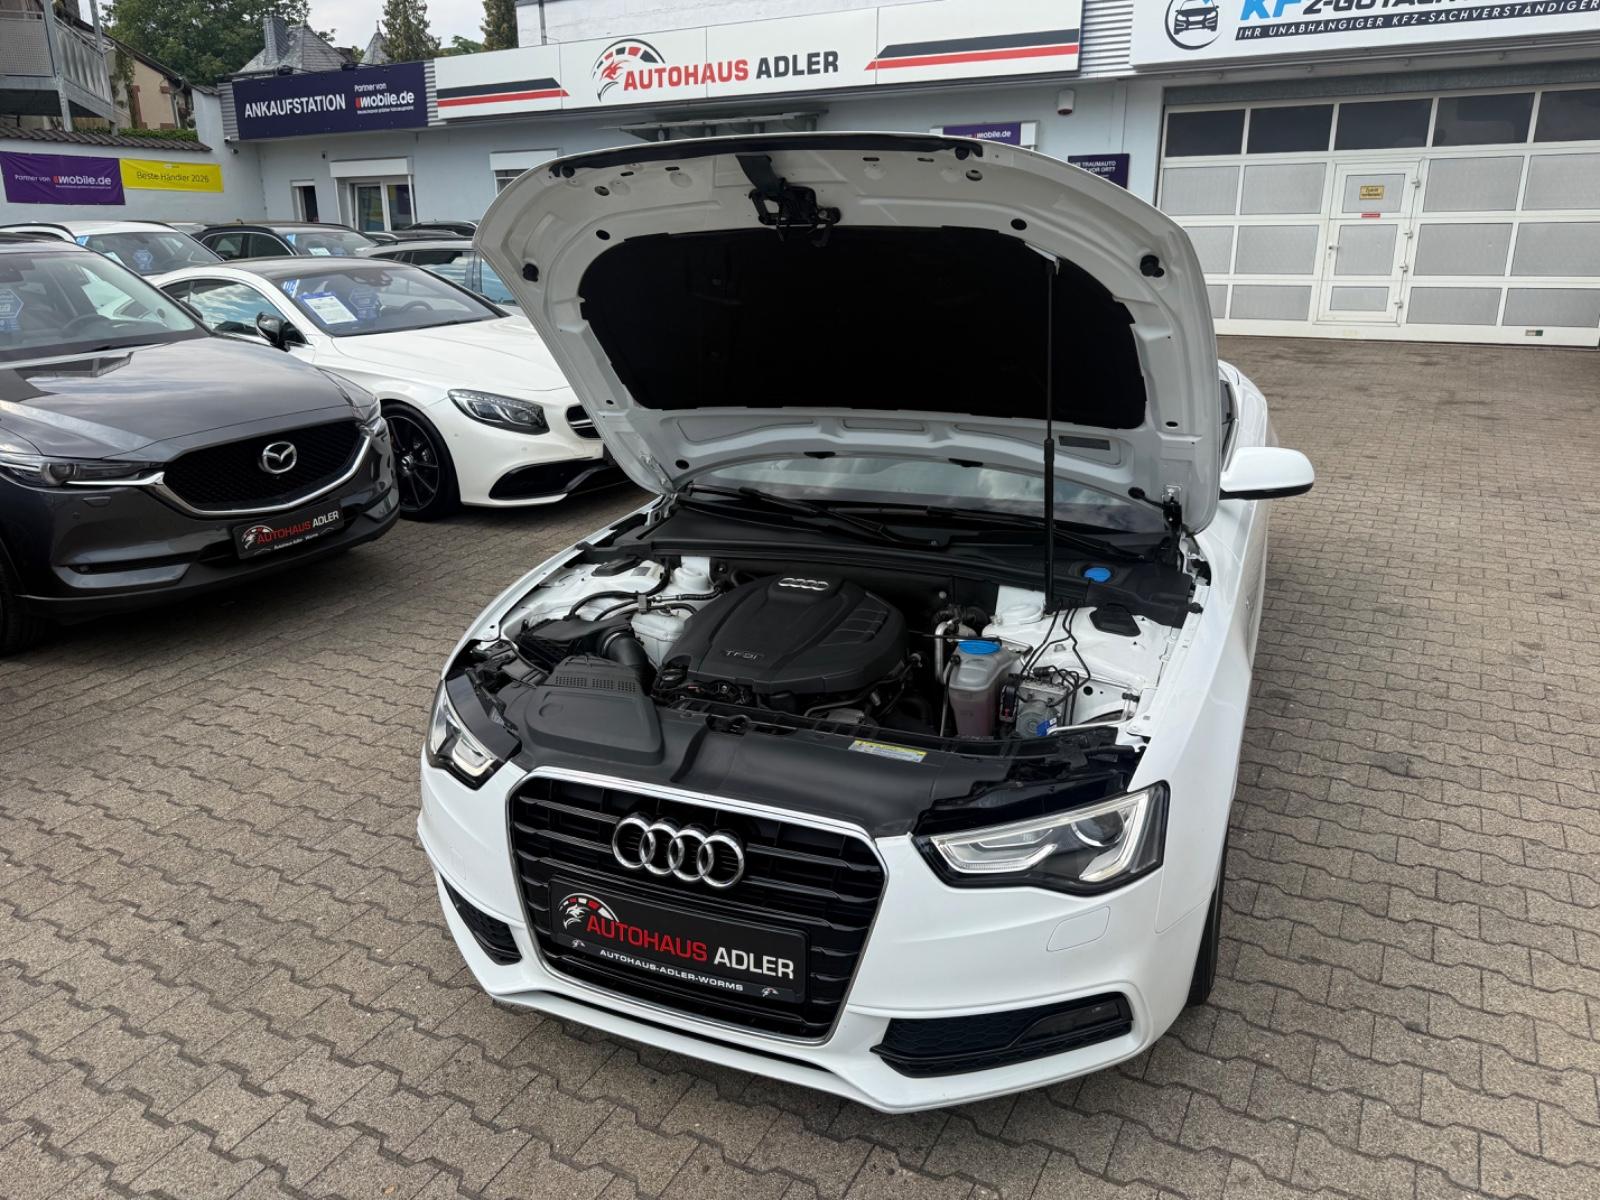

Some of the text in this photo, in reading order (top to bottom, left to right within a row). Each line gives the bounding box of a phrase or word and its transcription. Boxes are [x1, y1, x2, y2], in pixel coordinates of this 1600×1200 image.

[1238, 0, 1599, 38] IHR UNABHÄNGIGER KFZ-SACHVERSTÄNDIGER
[623, 50, 839, 91] AUTOHAUS ADLER
[354, 82, 387, 92] Partner von
[244, 93, 346, 118] ANKAUFSTATION
[360, 91, 415, 108] mobile.de
[976, 130, 1012, 139] mobile.de
[58, 175, 112, 185] mobile.de
[136, 171, 210, 183] Beste Händler 2026
[256, 520, 311, 544] AUTOHAUS
[312, 510, 340, 528] ADLER
[586, 914, 795, 980] AUTOHAUS ADLER
